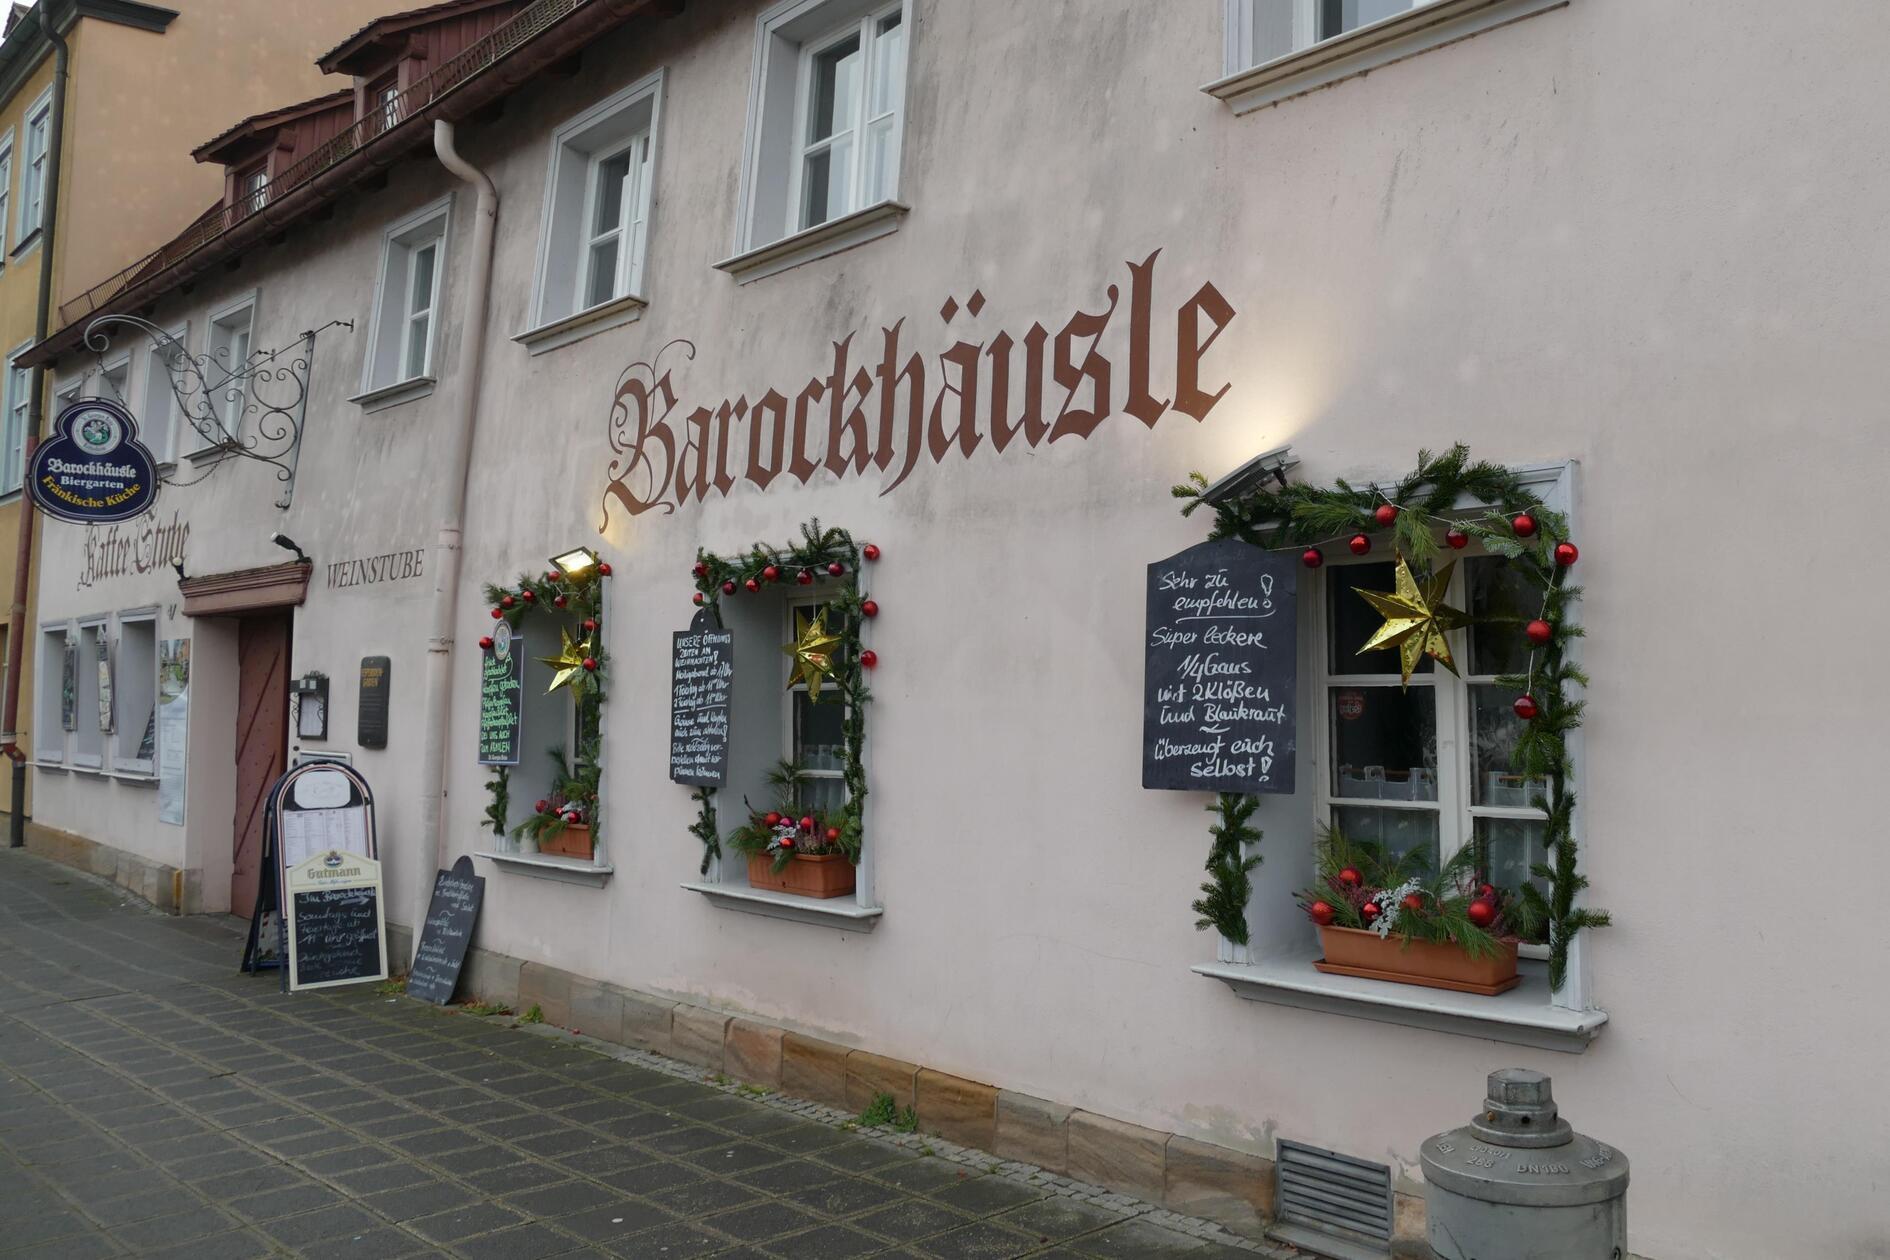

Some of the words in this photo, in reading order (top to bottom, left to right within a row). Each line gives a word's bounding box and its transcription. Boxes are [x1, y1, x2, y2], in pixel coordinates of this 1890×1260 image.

[600, 247, 1236, 534] Barockhäusle
[48, 458, 137, 478] Barockhäusle
[42, 475, 104, 507] Fränkische
[105, 483, 140, 505] Küche
[60, 475, 124, 489] Biergarten
[77, 524, 130, 591] Kaffee
[131, 508, 190, 574] Stube
[327, 549, 424, 590] WEINSTUBE
[1159, 571, 1198, 590] Sehr
[677, 635, 701, 649] UNSERE
[1203, 625, 1267, 648] leckere
[701, 647, 711, 656] AN
[1158, 683, 1187, 703] mit
[307, 867, 361, 880] Gutmann
